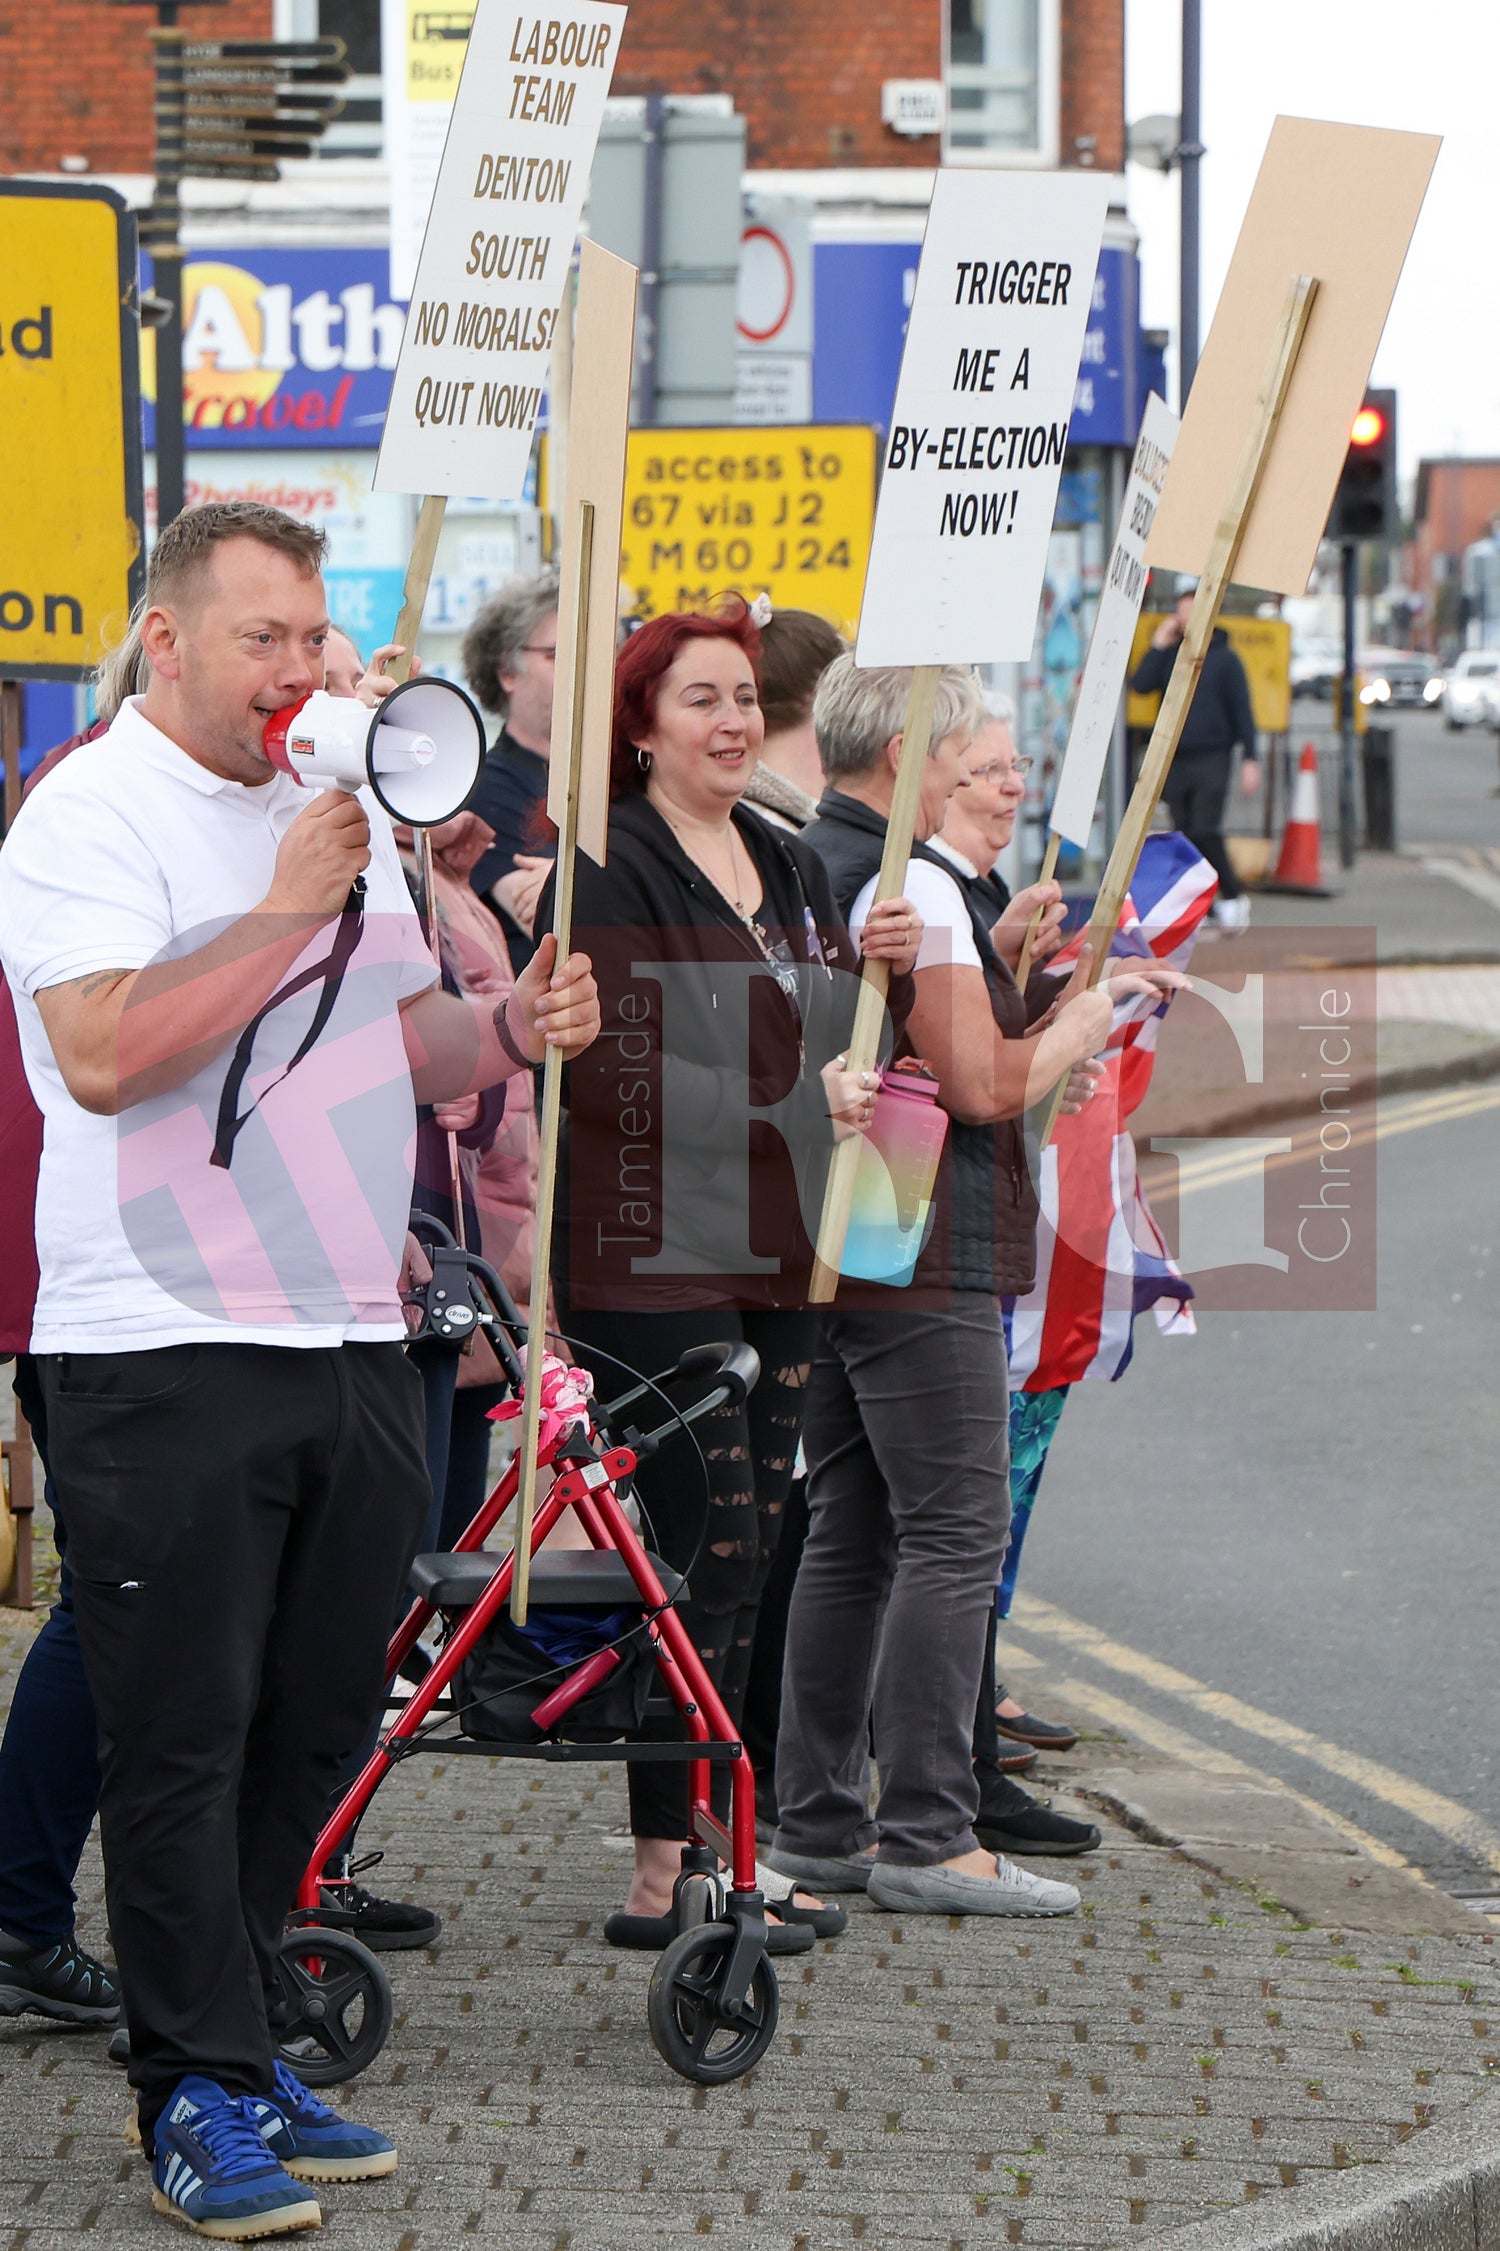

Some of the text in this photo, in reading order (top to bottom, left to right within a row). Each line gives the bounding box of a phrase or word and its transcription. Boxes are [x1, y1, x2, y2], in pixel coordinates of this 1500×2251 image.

[509, 17, 611, 68] LABOUR
[411, 61, 453, 82] Bus
[509, 75, 577, 126] TEAM
[474, 154, 572, 203] DENTON
[466, 230, 551, 281] SOUTH
[955, 260, 1072, 306] TRIGGER
[0, 306, 53, 360] d
[414, 301, 560, 351] NO MORALS!
[953, 348, 1029, 392] ME A
[183, 374, 356, 431] ravel
[415, 377, 541, 431] QUIT NOW!
[646, 446, 842, 482] access to
[888, 423, 1067, 471] BY-ELECTION
[631, 495, 682, 528] 67
[697, 495, 755, 527] via
[939, 490, 1018, 537] NOW!
